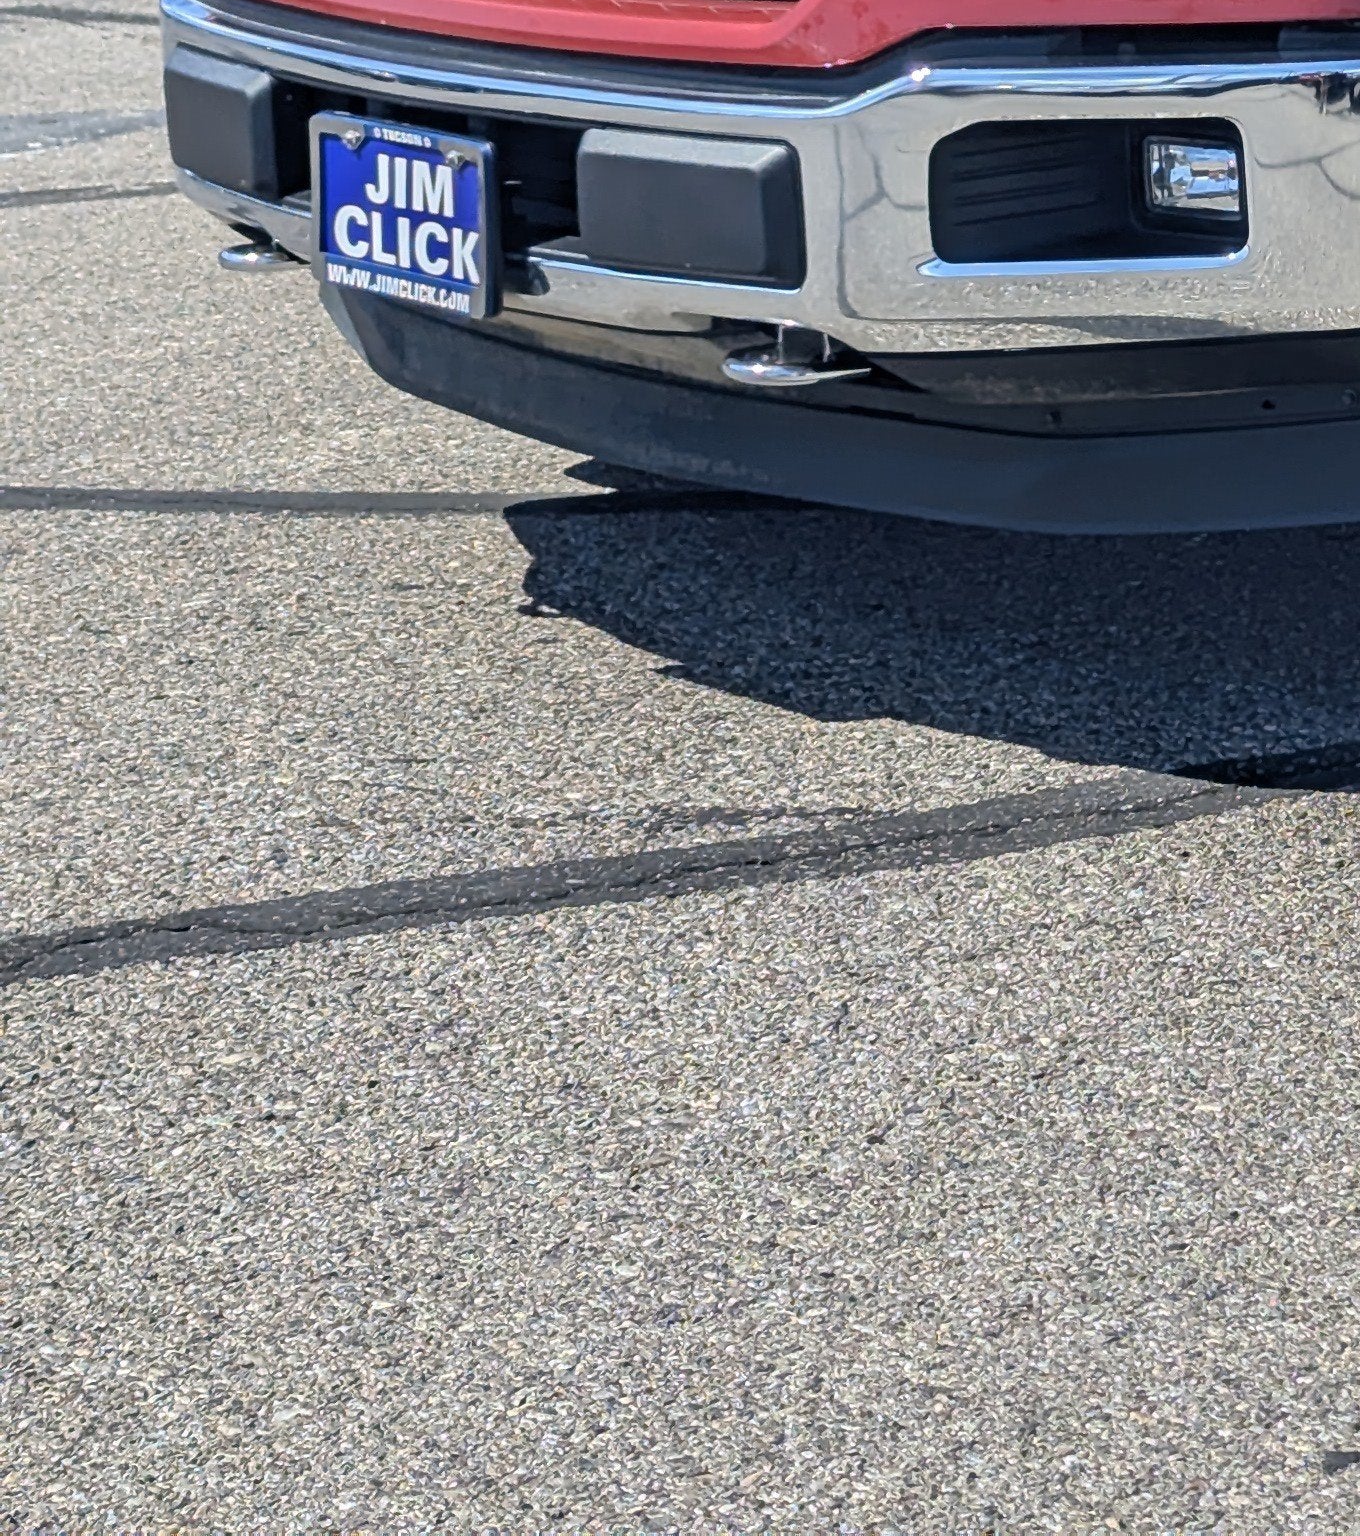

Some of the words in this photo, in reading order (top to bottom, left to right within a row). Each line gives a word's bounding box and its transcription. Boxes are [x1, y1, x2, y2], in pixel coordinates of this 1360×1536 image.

[365, 153, 454, 218] JIM
[334, 204, 481, 287] CLICK
[327, 262, 471, 314] WWW.JIMCLICK.COM
